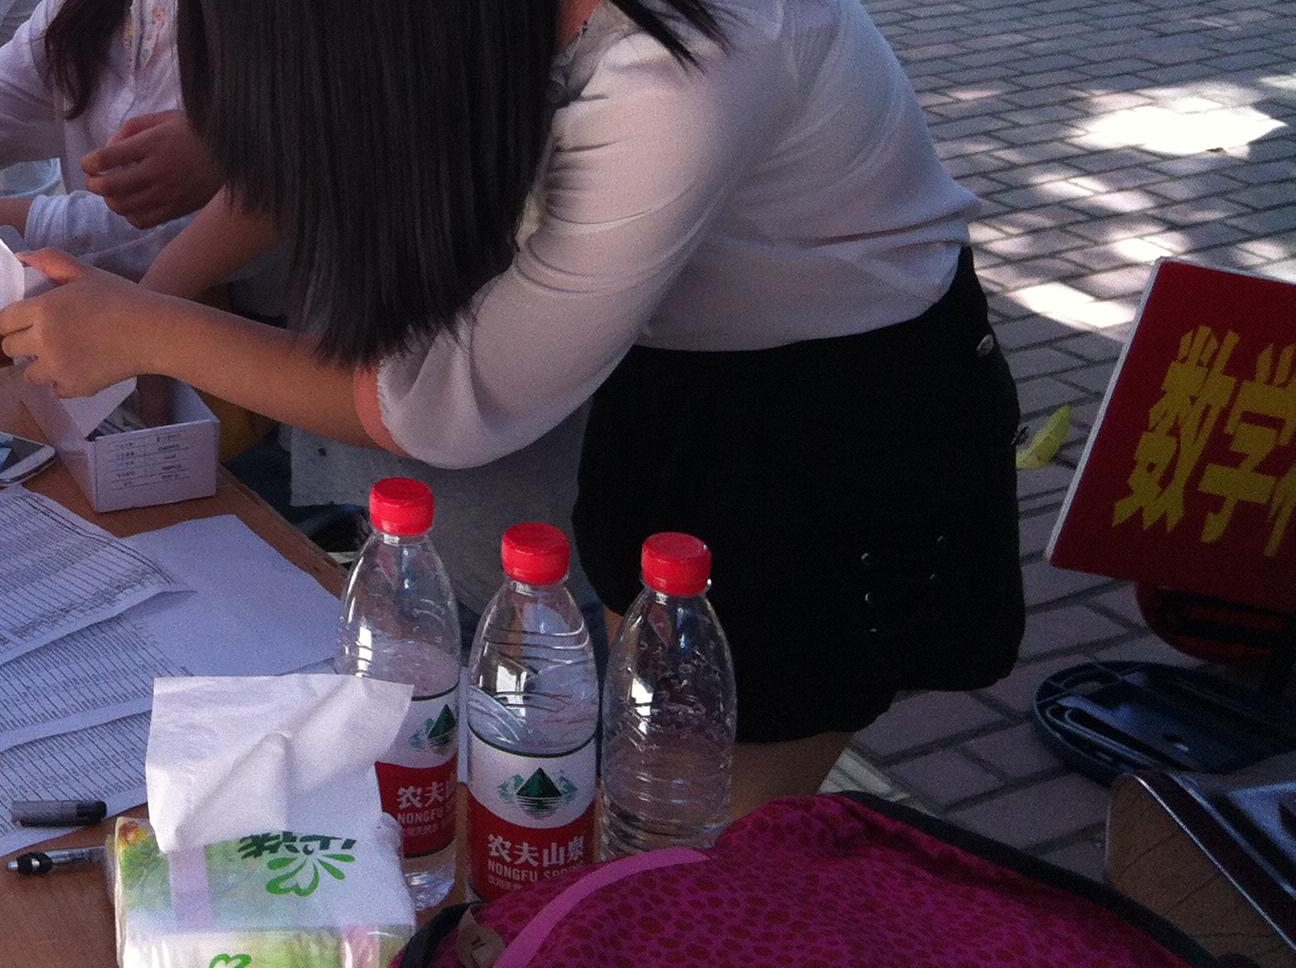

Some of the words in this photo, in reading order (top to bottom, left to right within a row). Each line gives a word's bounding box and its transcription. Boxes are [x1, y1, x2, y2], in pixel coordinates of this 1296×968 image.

[487, 833, 584, 867] 农夫山泉
[487, 859, 539, 882] NONGFU
